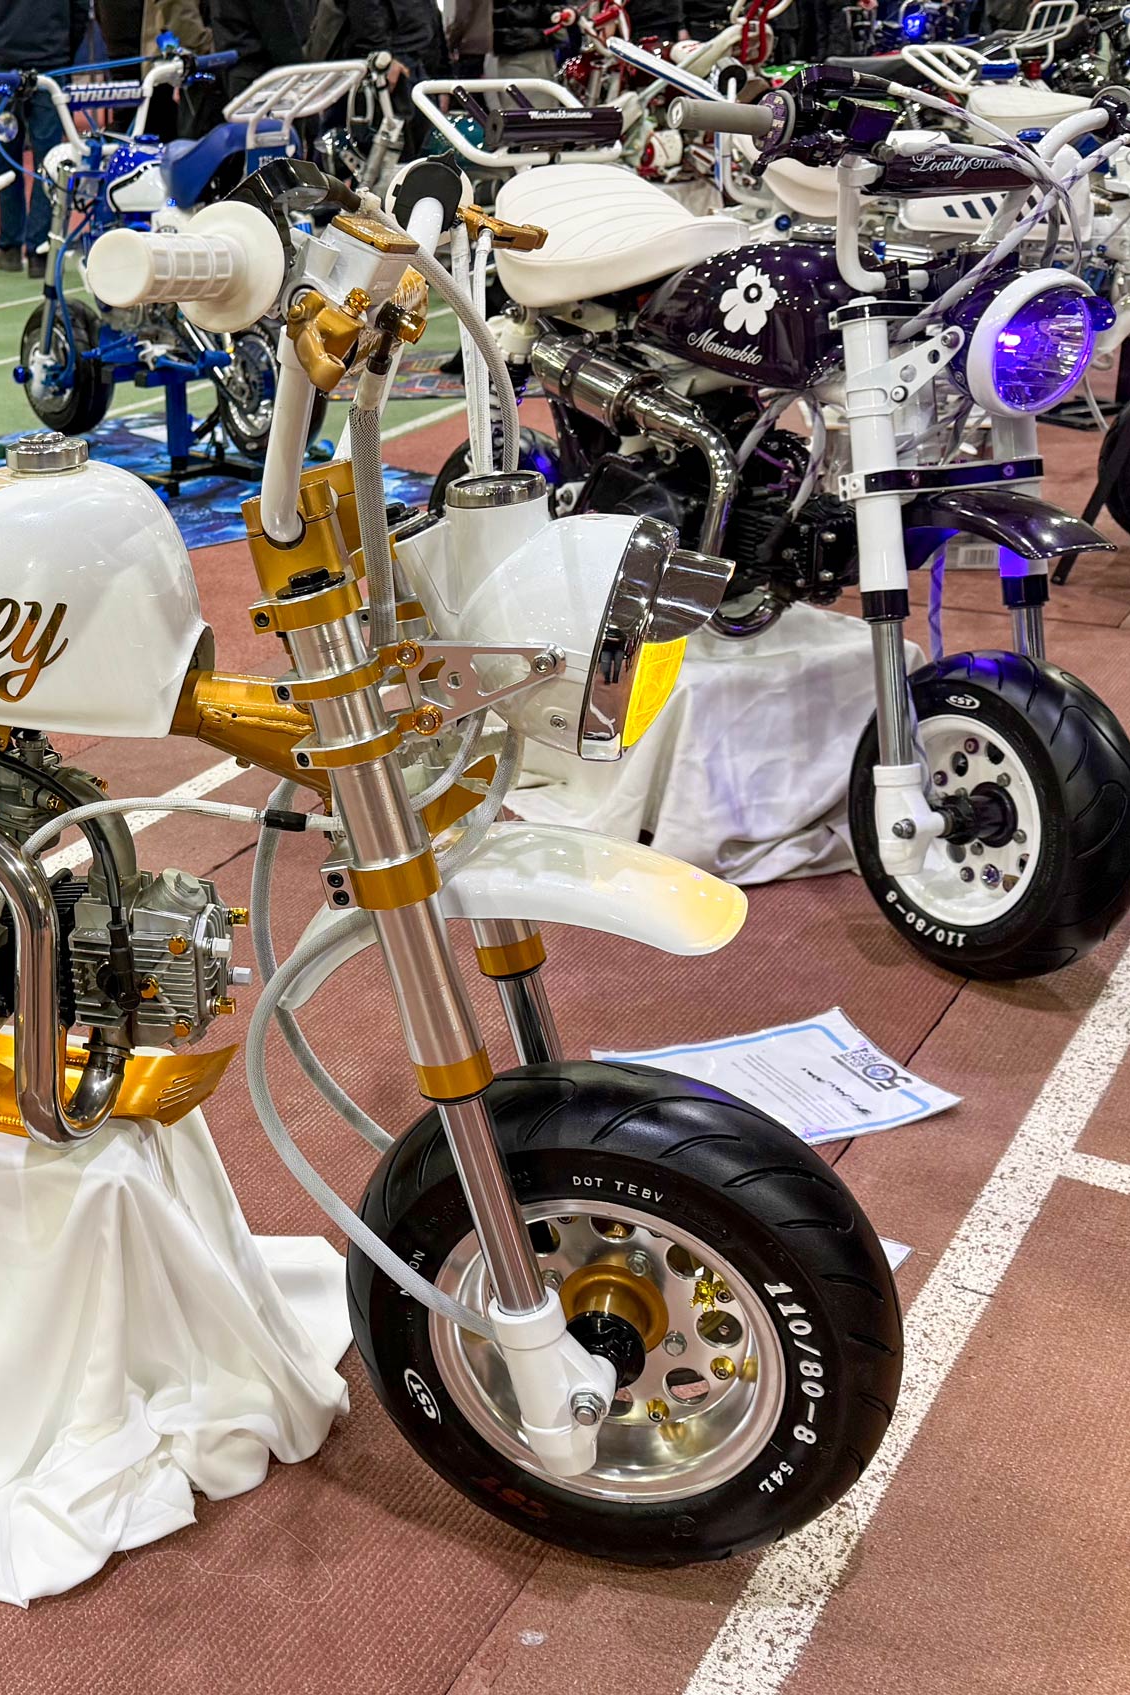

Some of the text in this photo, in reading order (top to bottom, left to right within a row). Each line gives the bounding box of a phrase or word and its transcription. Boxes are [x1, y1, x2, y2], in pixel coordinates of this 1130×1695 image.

[70, 88, 142, 103] RENTHAL
[687, 328, 763, 365] Marimekko
[947, 694, 974, 707] CST
[886, 890, 966, 947] 110/80-8
[573, 1176, 664, 1202] DOT TEBV
[407, 1377, 438, 1421] CST
[759, 1282, 825, 1493] 110/80-8 54L
